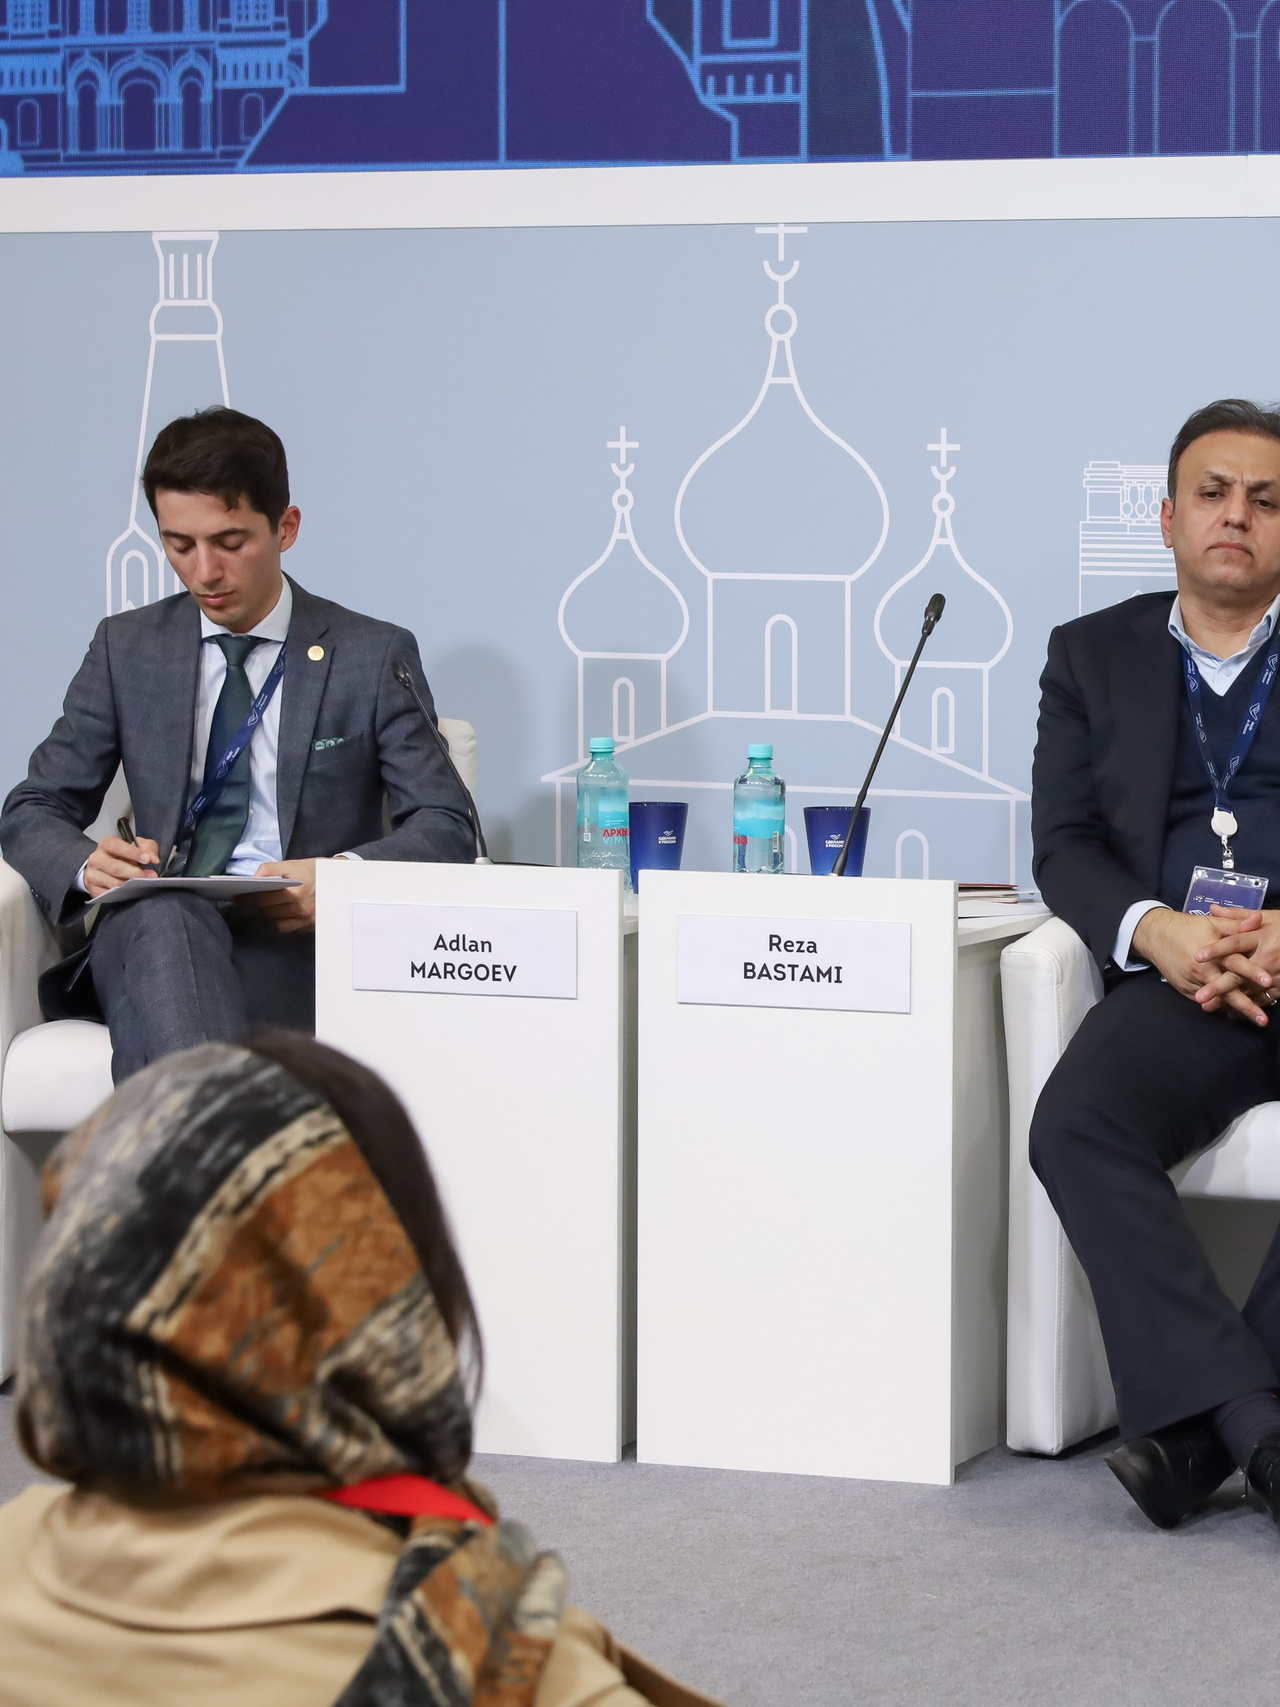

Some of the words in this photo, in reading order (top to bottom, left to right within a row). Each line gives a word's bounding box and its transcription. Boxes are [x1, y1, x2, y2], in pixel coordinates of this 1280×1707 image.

[433, 933, 493, 953] Adlan
[768, 934, 818, 954] Reza
[410, 961, 517, 982] MARGOEV
[743, 962, 843, 983] BASTAMI
